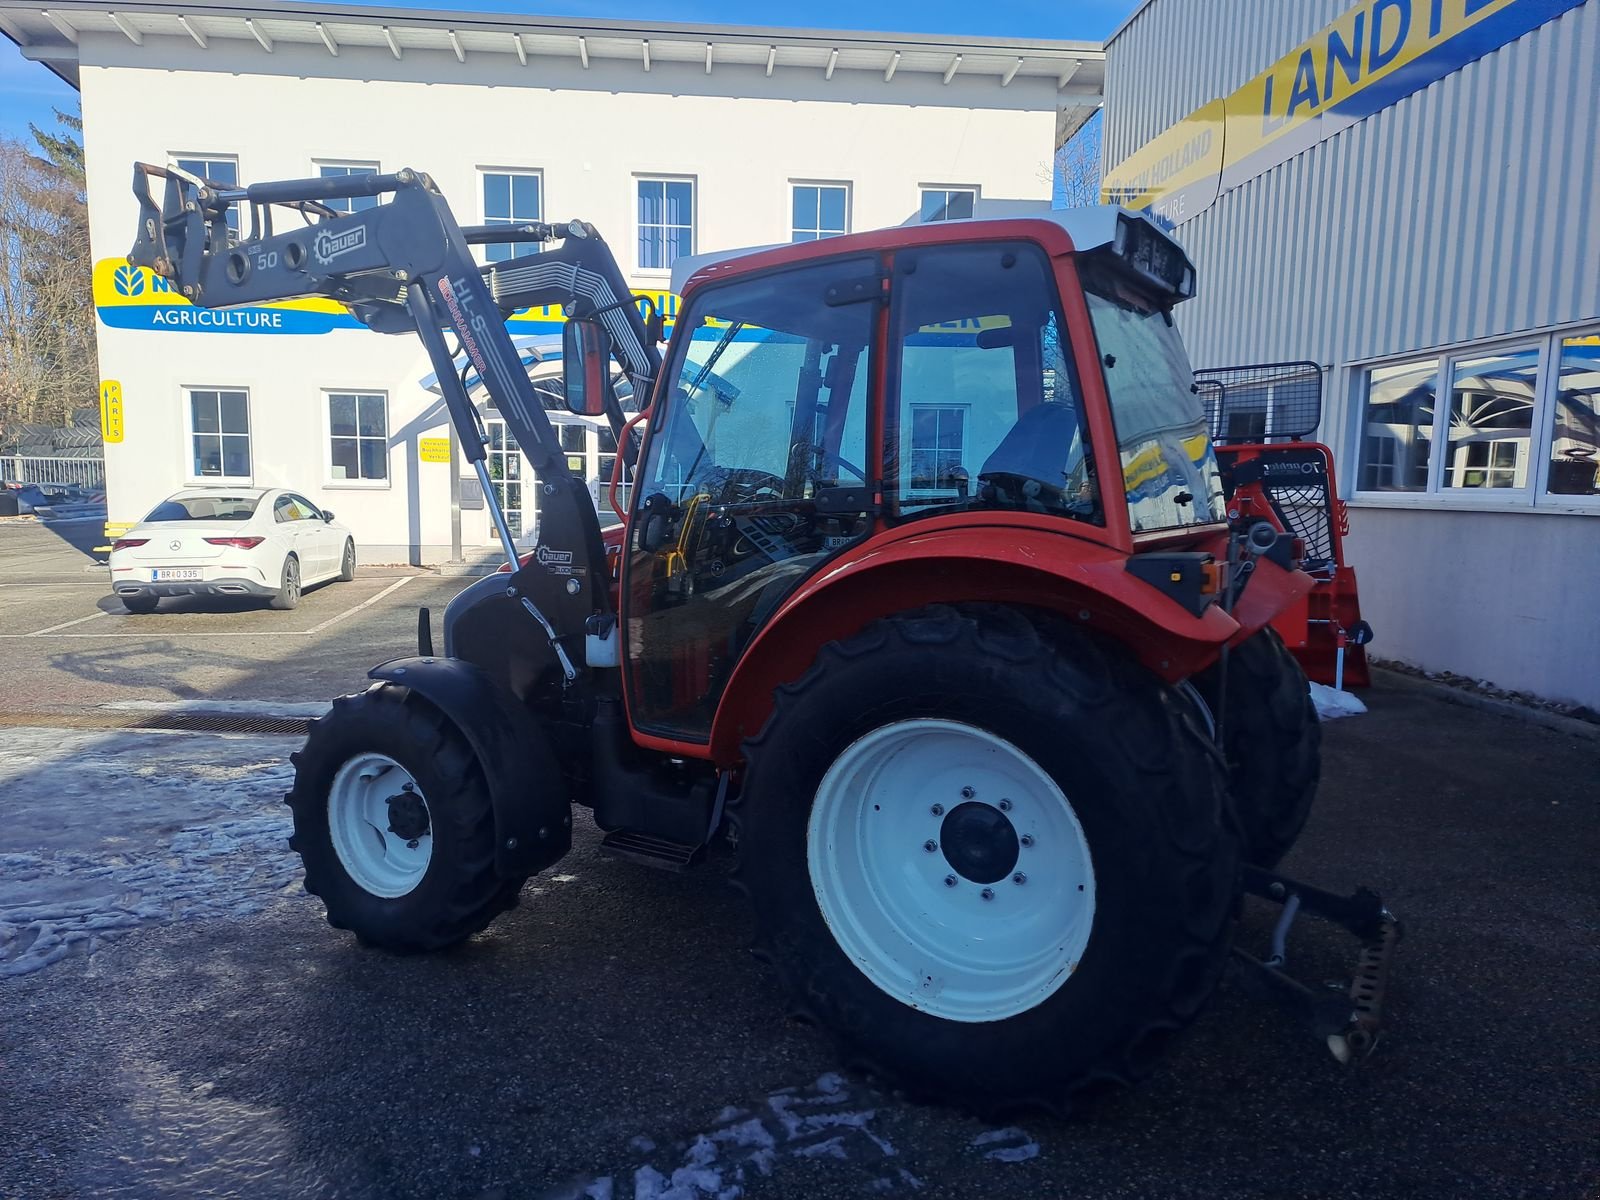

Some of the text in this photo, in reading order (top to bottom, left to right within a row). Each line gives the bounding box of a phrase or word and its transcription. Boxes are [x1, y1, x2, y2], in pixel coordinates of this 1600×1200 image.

[1262, 0, 1496, 138] LAND
[1151, 128, 1213, 188] HOLLAND
[322, 230, 361, 257] hauer
[257, 251, 278, 270] 50
[152, 309, 283, 328] AGRICULTURE
[111, 385, 120, 437] PARTS
[541, 549, 570, 561] hauer
